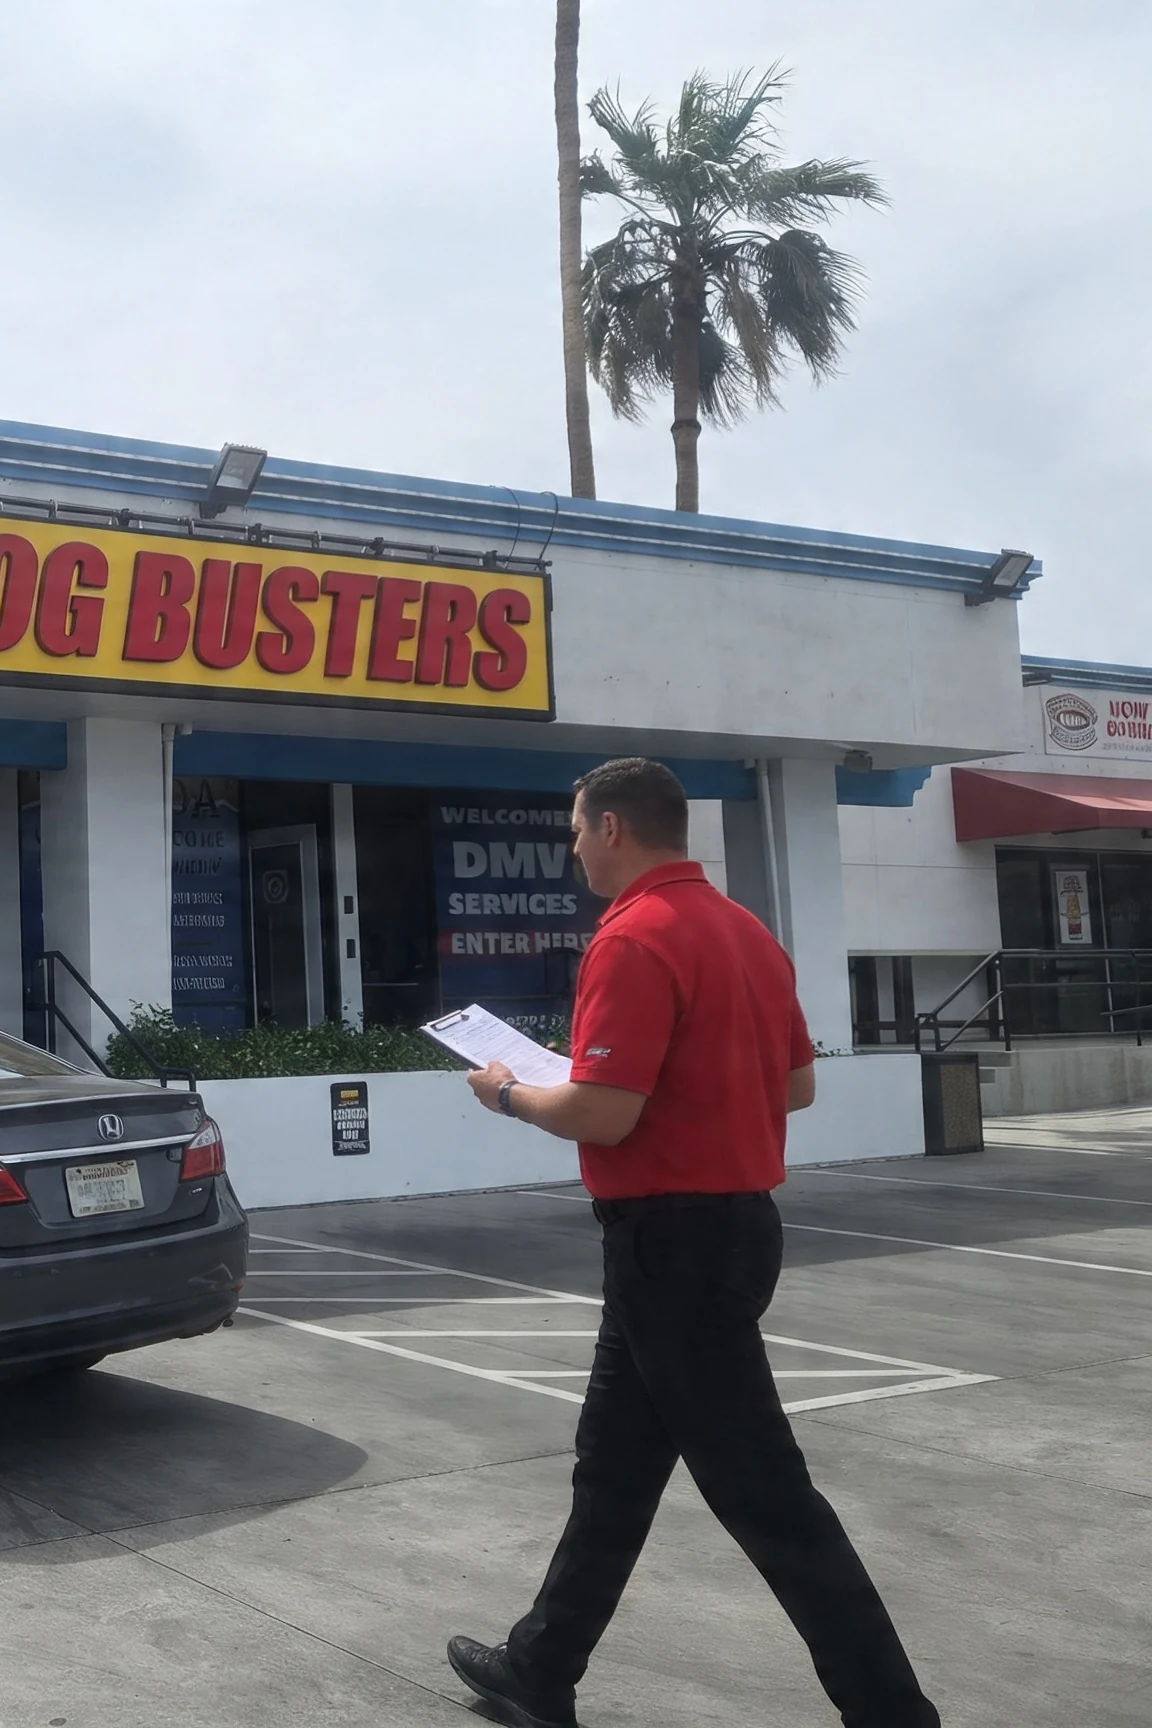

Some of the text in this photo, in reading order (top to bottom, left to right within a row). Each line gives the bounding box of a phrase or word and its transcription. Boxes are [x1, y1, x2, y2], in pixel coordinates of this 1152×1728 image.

[122, 550, 532, 692] BUSTERS
[440, 807, 571, 827] WELCOME
[453, 841, 567, 879] DMV
[448, 892, 578, 916] SERVICES
[451, 932, 530, 955] ENTER
